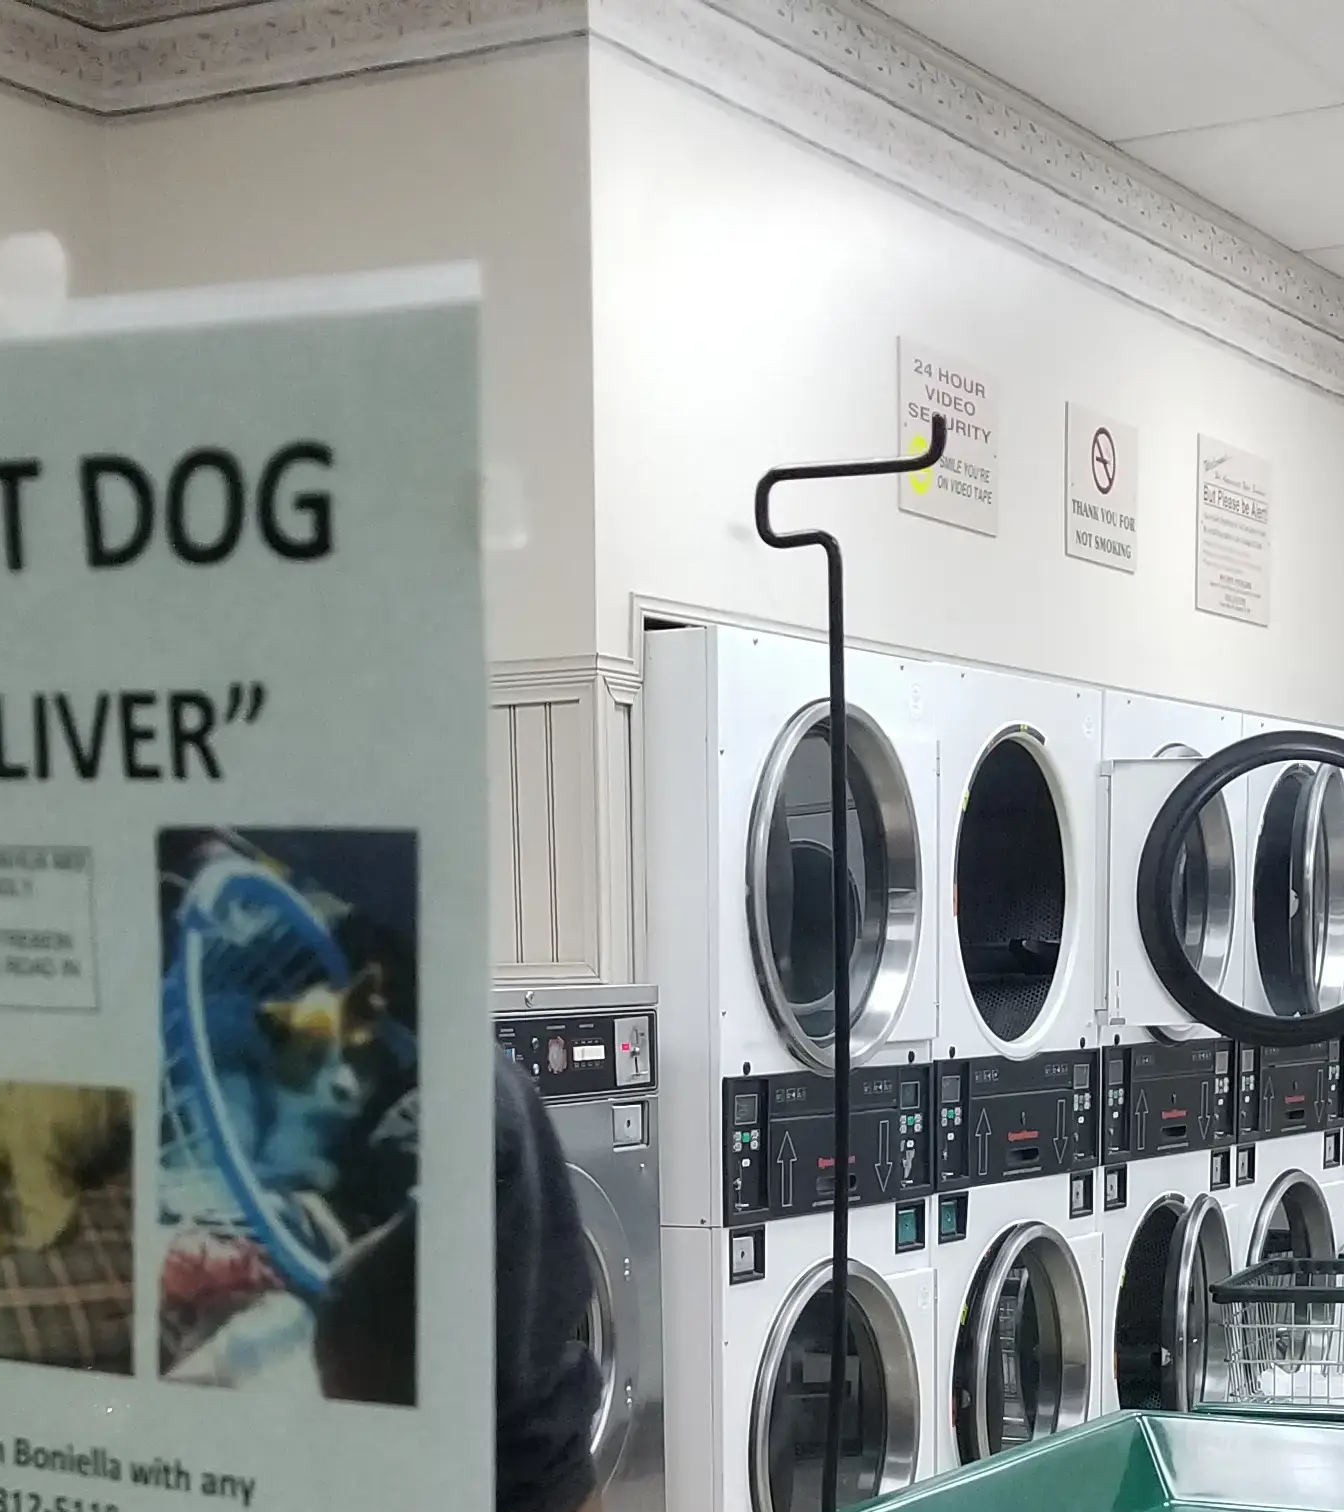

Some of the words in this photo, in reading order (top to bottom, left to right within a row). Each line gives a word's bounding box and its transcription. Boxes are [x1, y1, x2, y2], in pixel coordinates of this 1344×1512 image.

[913, 358, 932, 378] 24
[938, 367, 986, 399] HOUR
[925, 384, 976, 416] VIDEO
[939, 454, 962, 475] SMILE
[79, 440, 337, 570] DOG
[937, 475, 949, 491] ON
[950, 478, 972, 498] VIDEO
[974, 485, 992, 505] TAPE
[1072, 498, 1099, 521] THANK
[1101, 508, 1117, 527] YOU
[1119, 514, 1136, 532] FOR
[1076, 529, 1092, 548] NOT
[1094, 535, 1132, 559] SMOKING
[14, 1437, 122, 1482] Boniella
[129, 1456, 191, 1492] with
[200, 1471, 255, 1508] any
